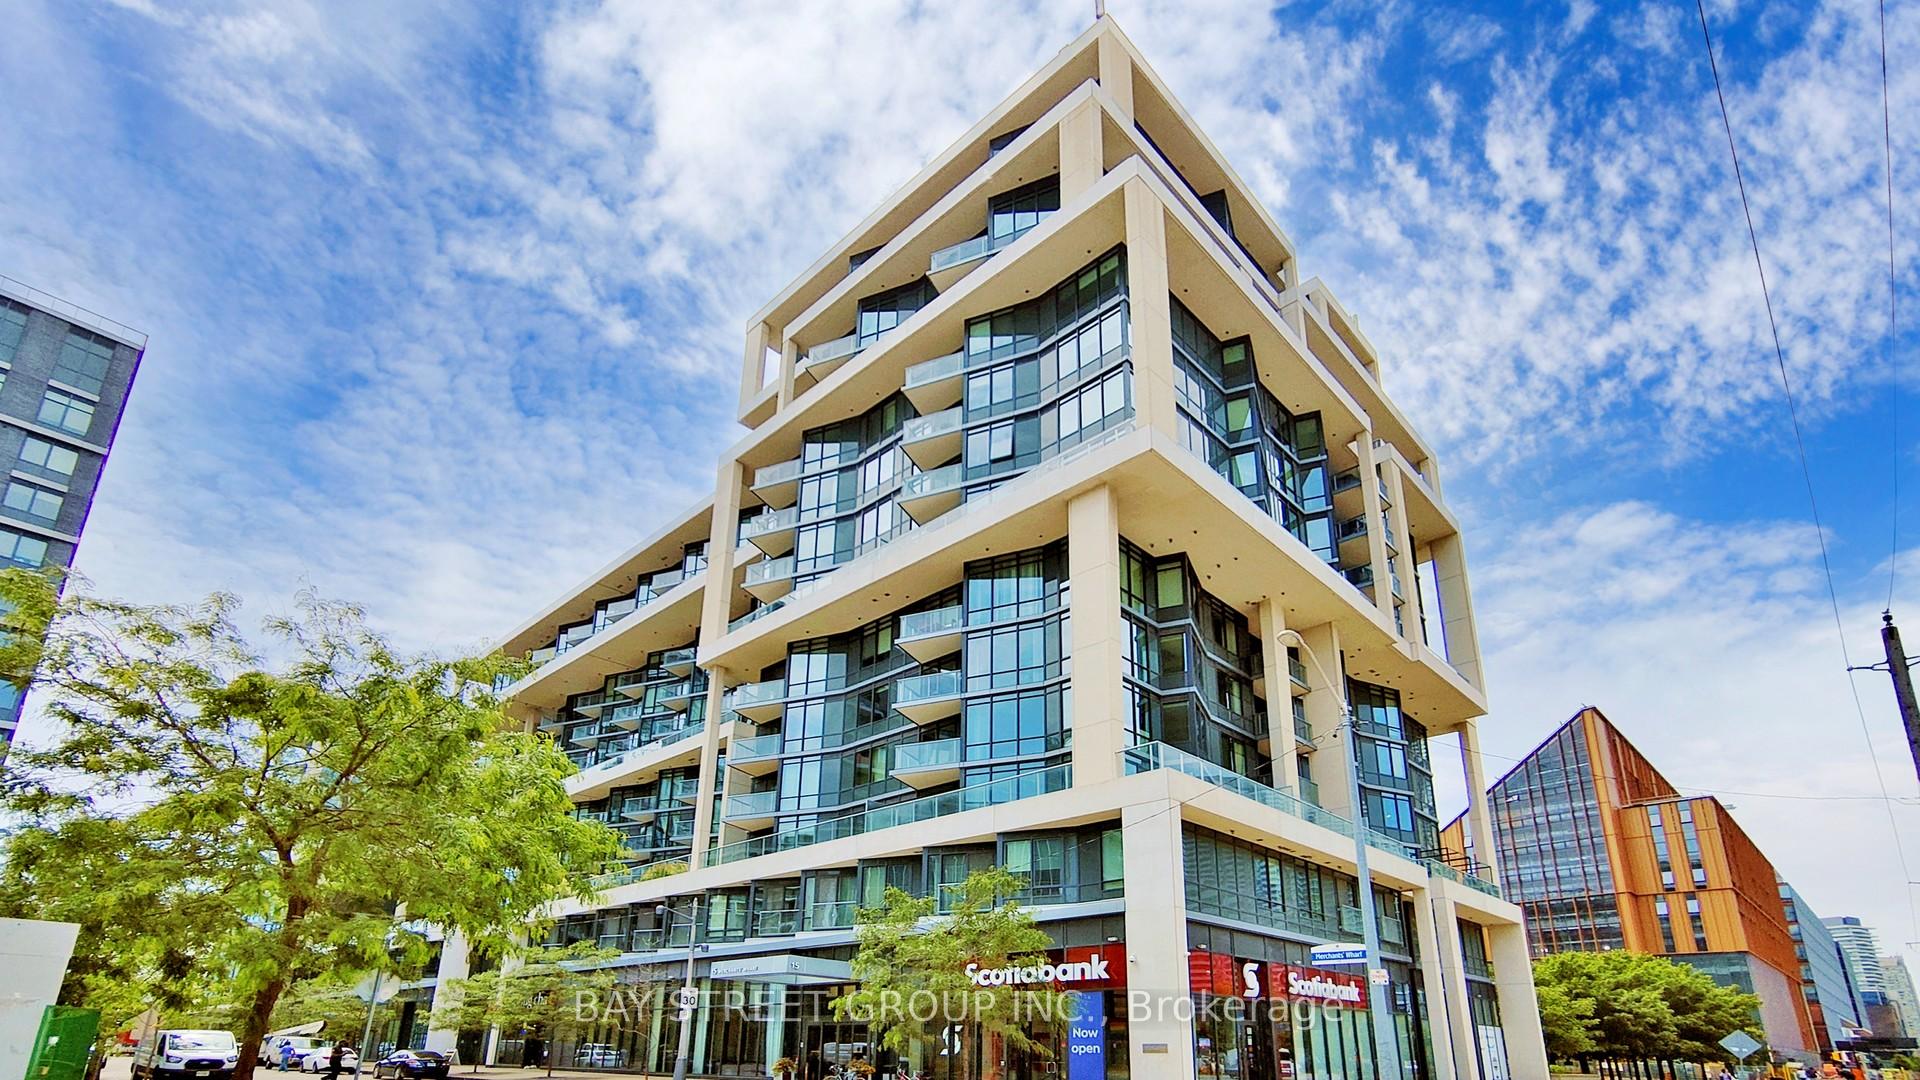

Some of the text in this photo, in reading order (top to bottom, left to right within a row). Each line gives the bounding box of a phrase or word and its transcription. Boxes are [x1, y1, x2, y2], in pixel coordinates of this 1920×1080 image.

[791, 961, 800, 970] 15
[1288, 972, 1360, 1002] Scotiabank
[683, 996, 696, 1005] 30
[1072, 1027, 1099, 1038] Now
[1071, 1044, 1100, 1056] open
